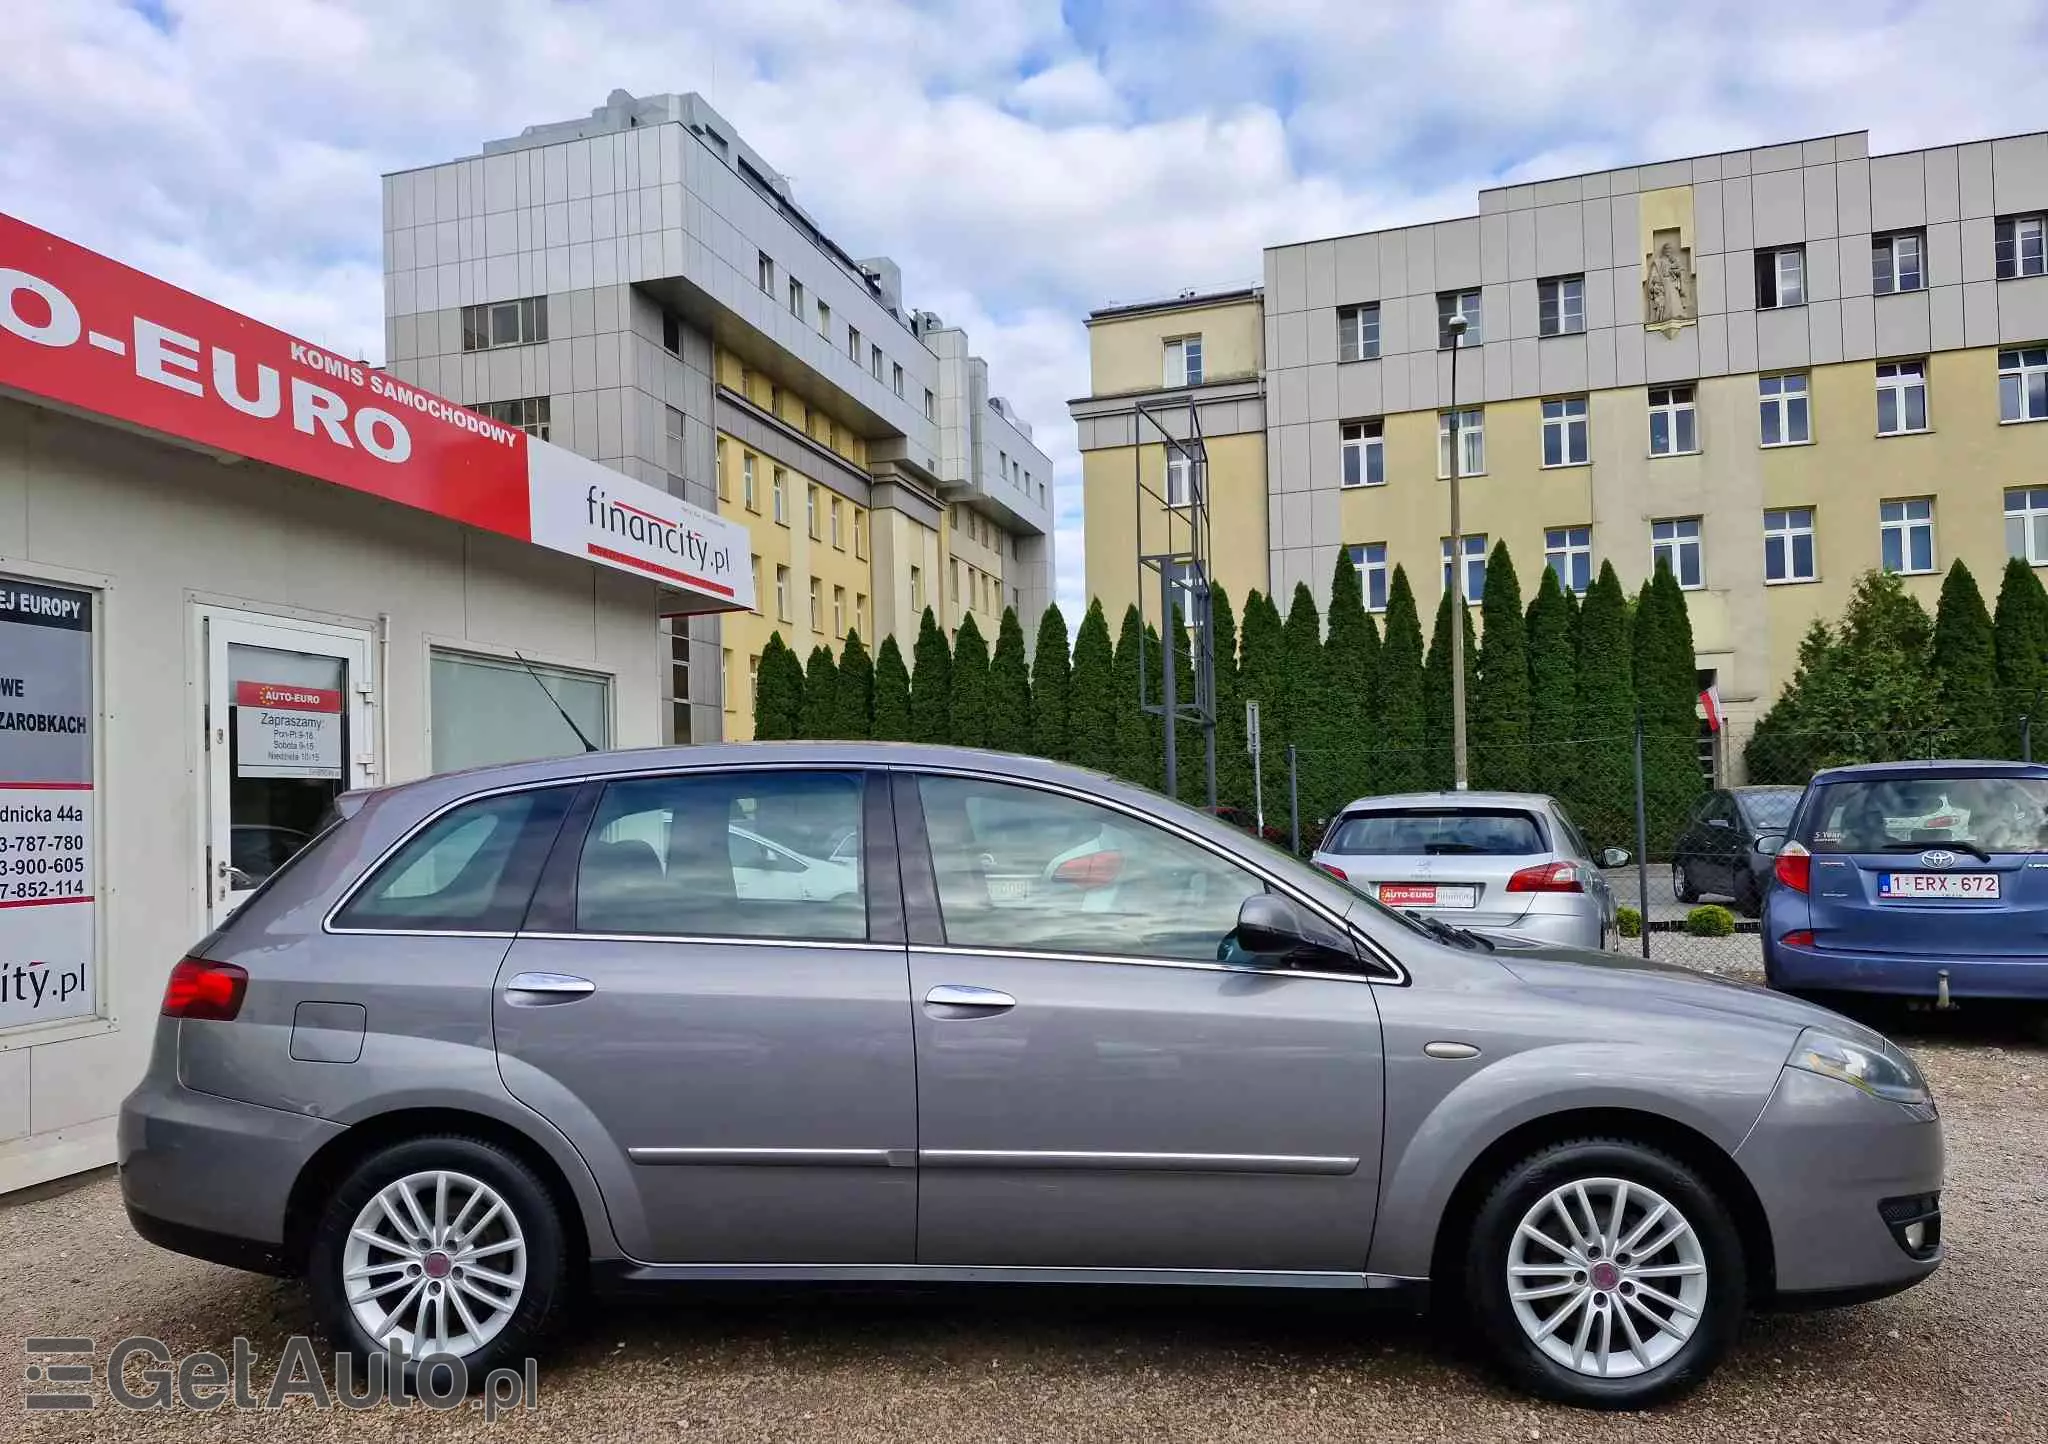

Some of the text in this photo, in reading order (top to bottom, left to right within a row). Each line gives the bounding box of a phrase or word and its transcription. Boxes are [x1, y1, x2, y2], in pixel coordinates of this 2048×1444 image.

[290, 341, 517, 448] KOMIS SAMOCHODOWY
[586, 485, 731, 576] financity.pl
[20, 593, 81, 619] EUROPY
[265, 691, 320, 704] AUTO-EURO
[0, 711, 87, 734] ZAROBKACH
[0, 804, 83, 823] dnicka 44a
[0, 834, 83, 853] 3-787-780
[0, 856, 84, 876] 3-900-605
[0, 879, 84, 900] 7-852-114
[1384, 889, 1434, 899] AUTO-EURO
